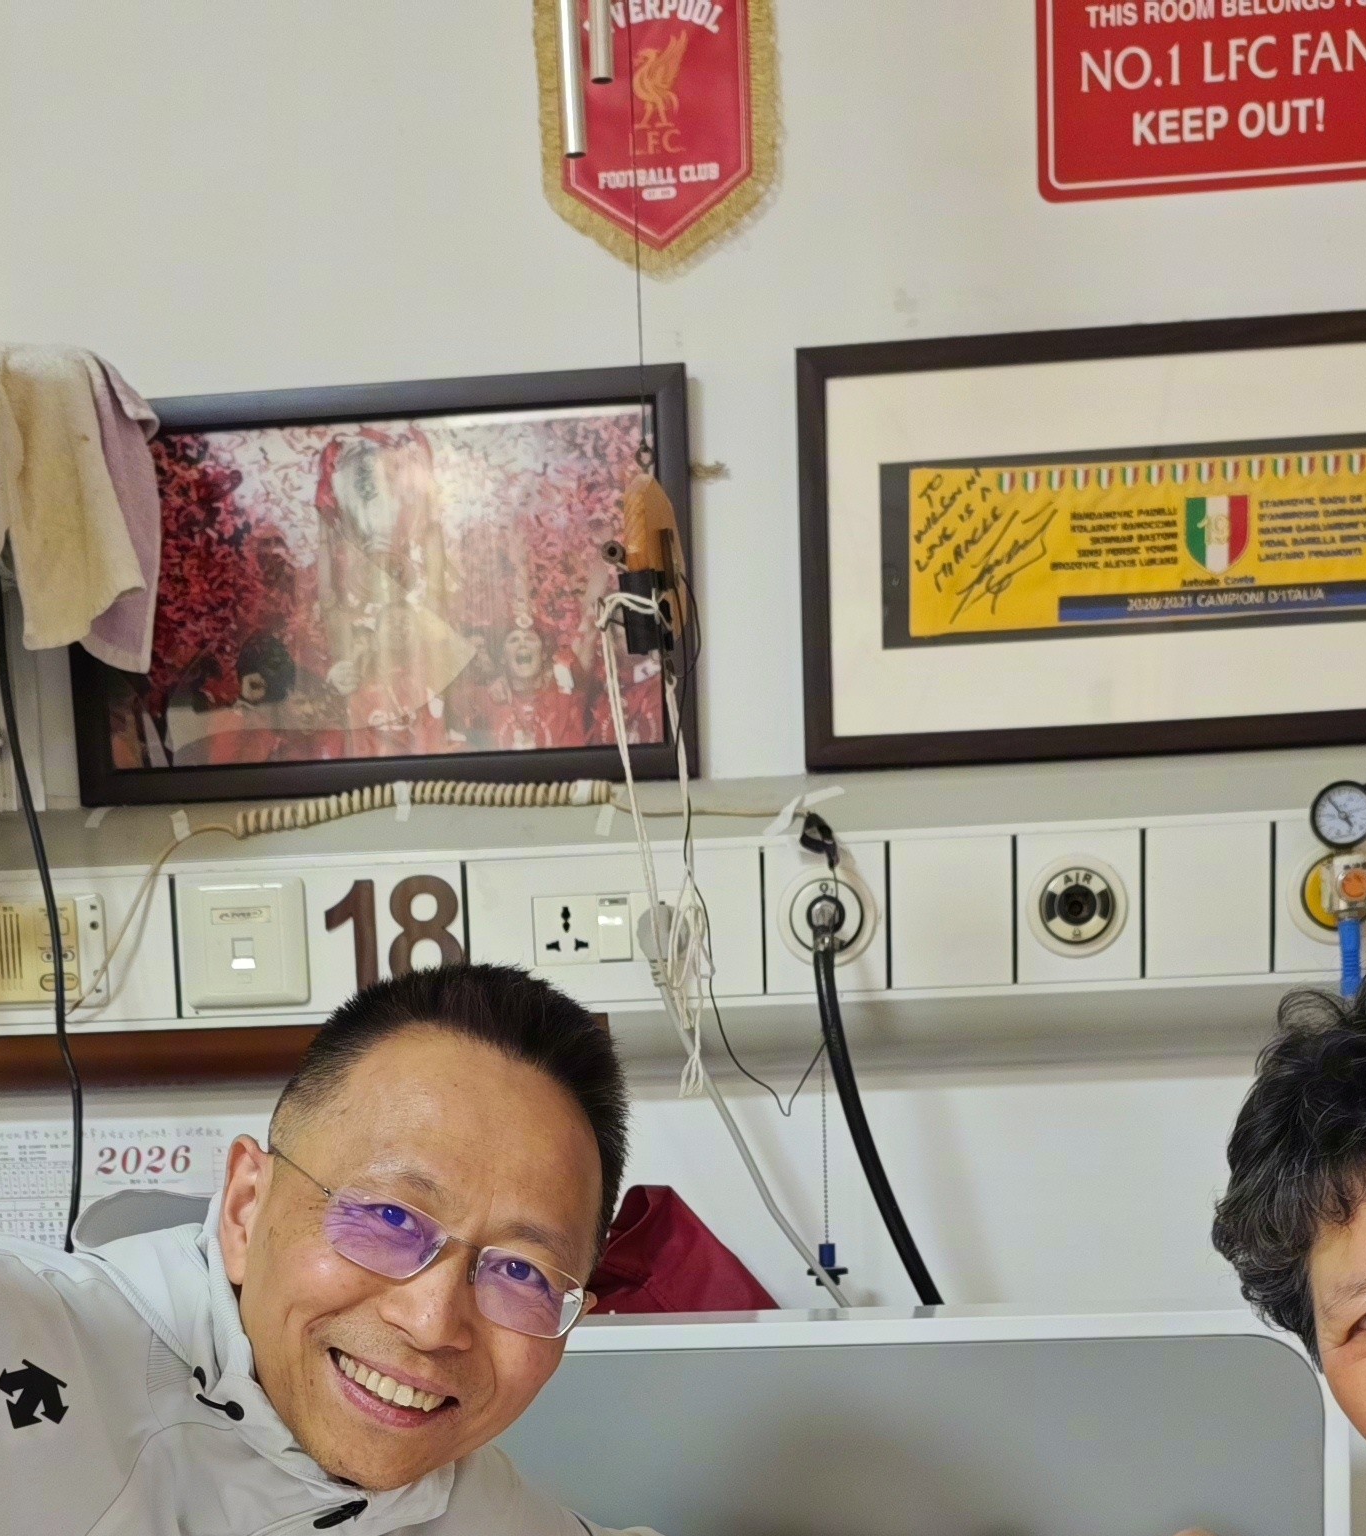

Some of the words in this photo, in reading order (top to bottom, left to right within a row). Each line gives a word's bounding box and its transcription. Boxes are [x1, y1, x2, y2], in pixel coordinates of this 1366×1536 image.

[583, 0, 723, 34] VERPOOL
[1085, 4, 1138, 29] THIS
[1144, 0, 1216, 25] ROOM
[1080, 42, 1181, 93] NO.1
[1202, 34, 1278, 84] LFC
[1132, 105, 1229, 146] KEEP
[1238, 97, 1325, 139] OUT!
[598, 167, 677, 189] FOOTBALL
[679, 162, 720, 183] CLUB
[1063, 873, 1094, 886] AIR
[324, 875, 463, 995] 18
[95, 1145, 191, 1176] 2026
